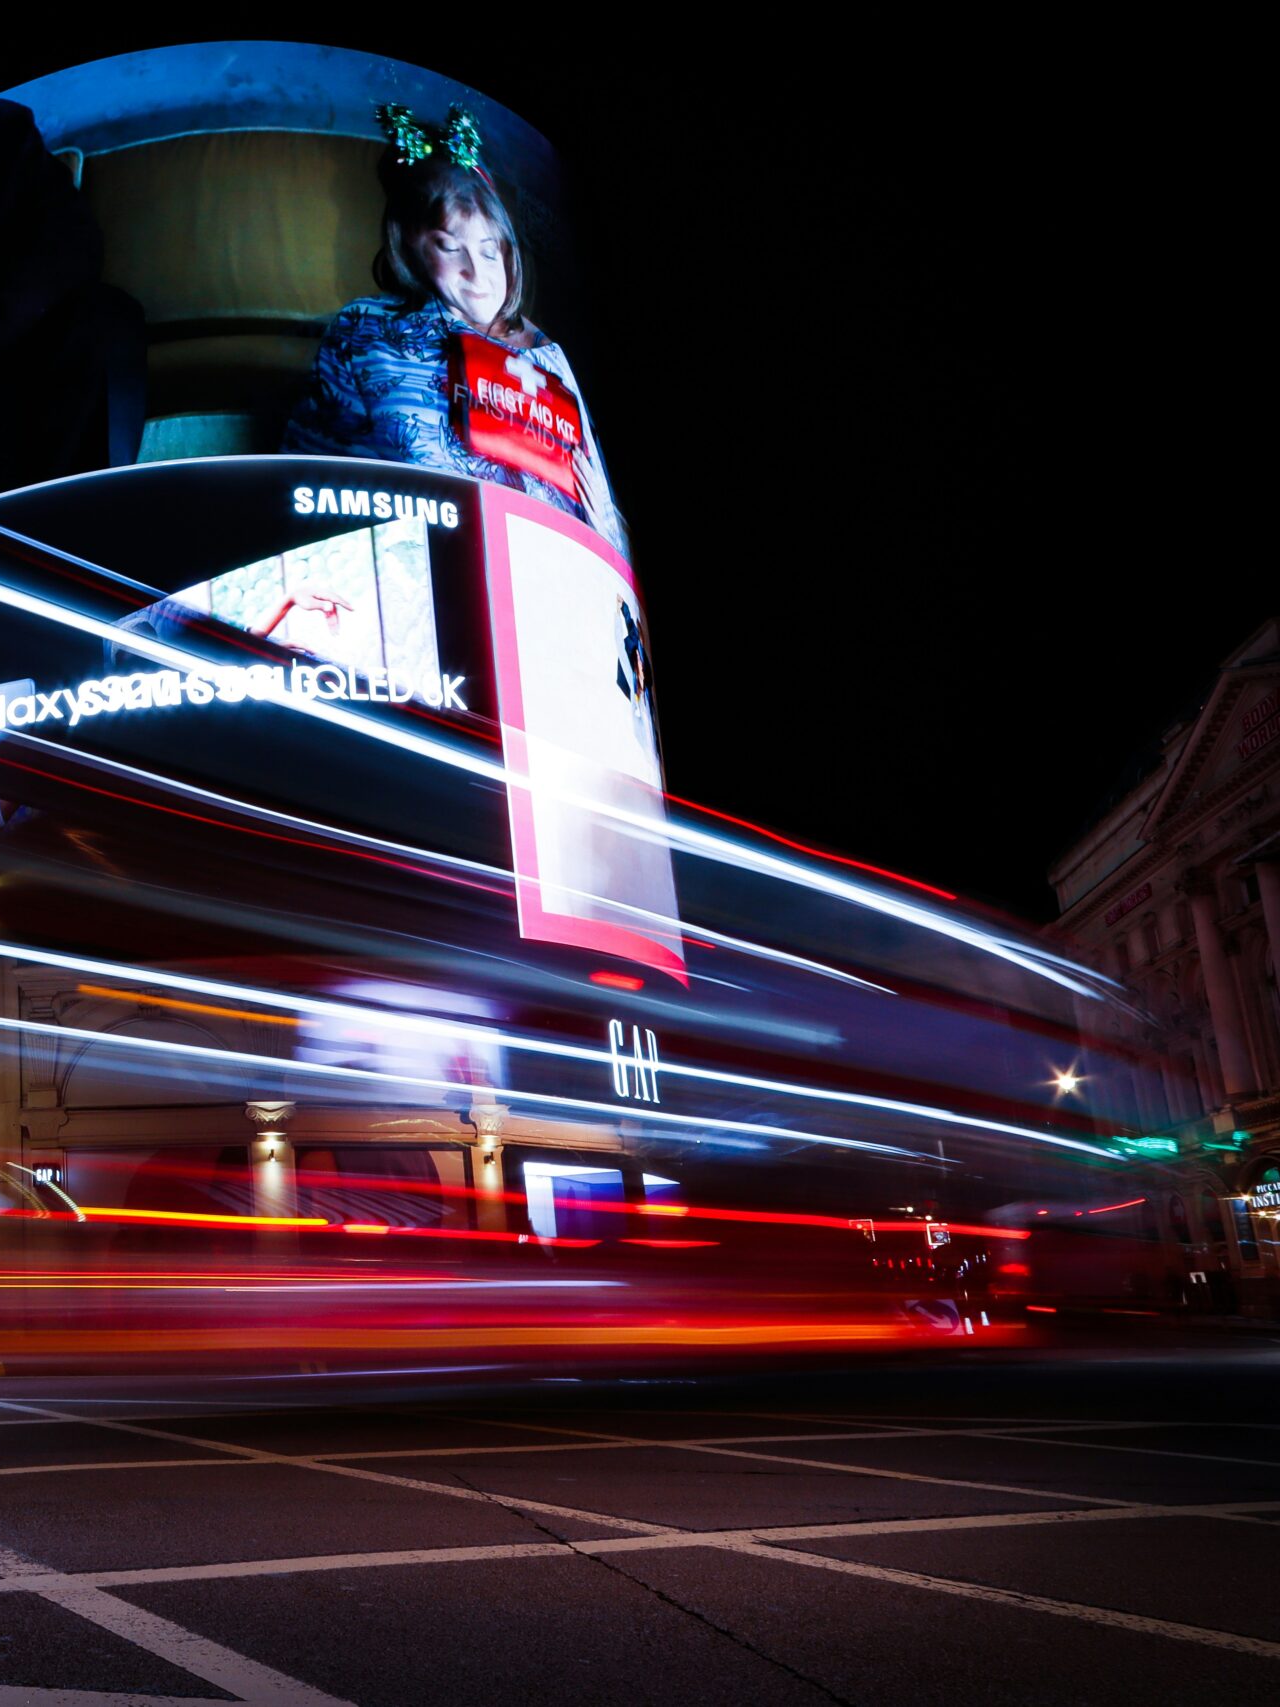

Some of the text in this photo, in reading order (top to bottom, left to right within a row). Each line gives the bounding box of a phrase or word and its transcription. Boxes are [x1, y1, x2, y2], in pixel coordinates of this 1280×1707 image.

[477, 376, 575, 443] FIRST AID KIT
[294, 487, 459, 528] SAMSUNG
[609, 1019, 661, 1104] GAP
